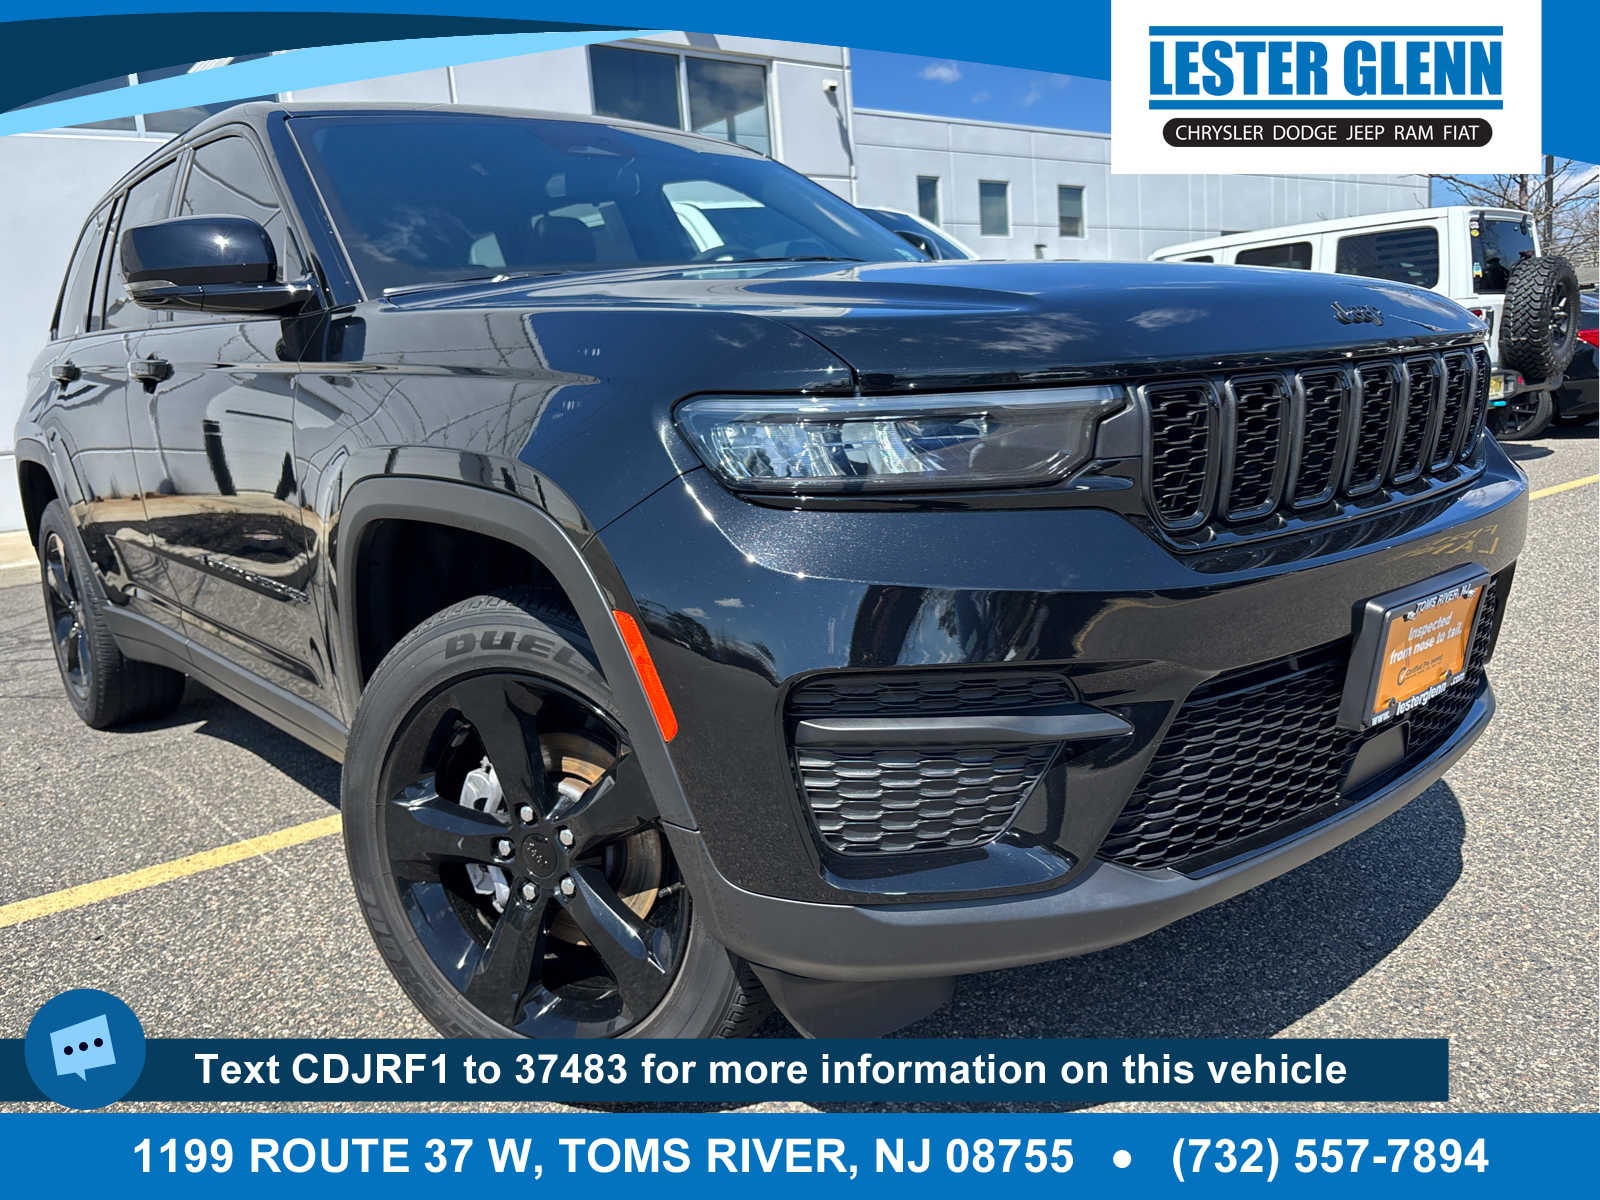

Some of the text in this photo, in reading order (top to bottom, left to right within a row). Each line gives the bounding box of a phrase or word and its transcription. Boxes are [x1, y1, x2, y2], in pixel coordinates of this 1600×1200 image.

[1330, 301, 1384, 326] Jeep
[1416, 596, 1438, 614] TOMS
[1408, 610, 1454, 640] Inspected
[1389, 645, 1413, 665] from
[1413, 636, 1436, 656] nose
[1436, 631, 1446, 645] to
